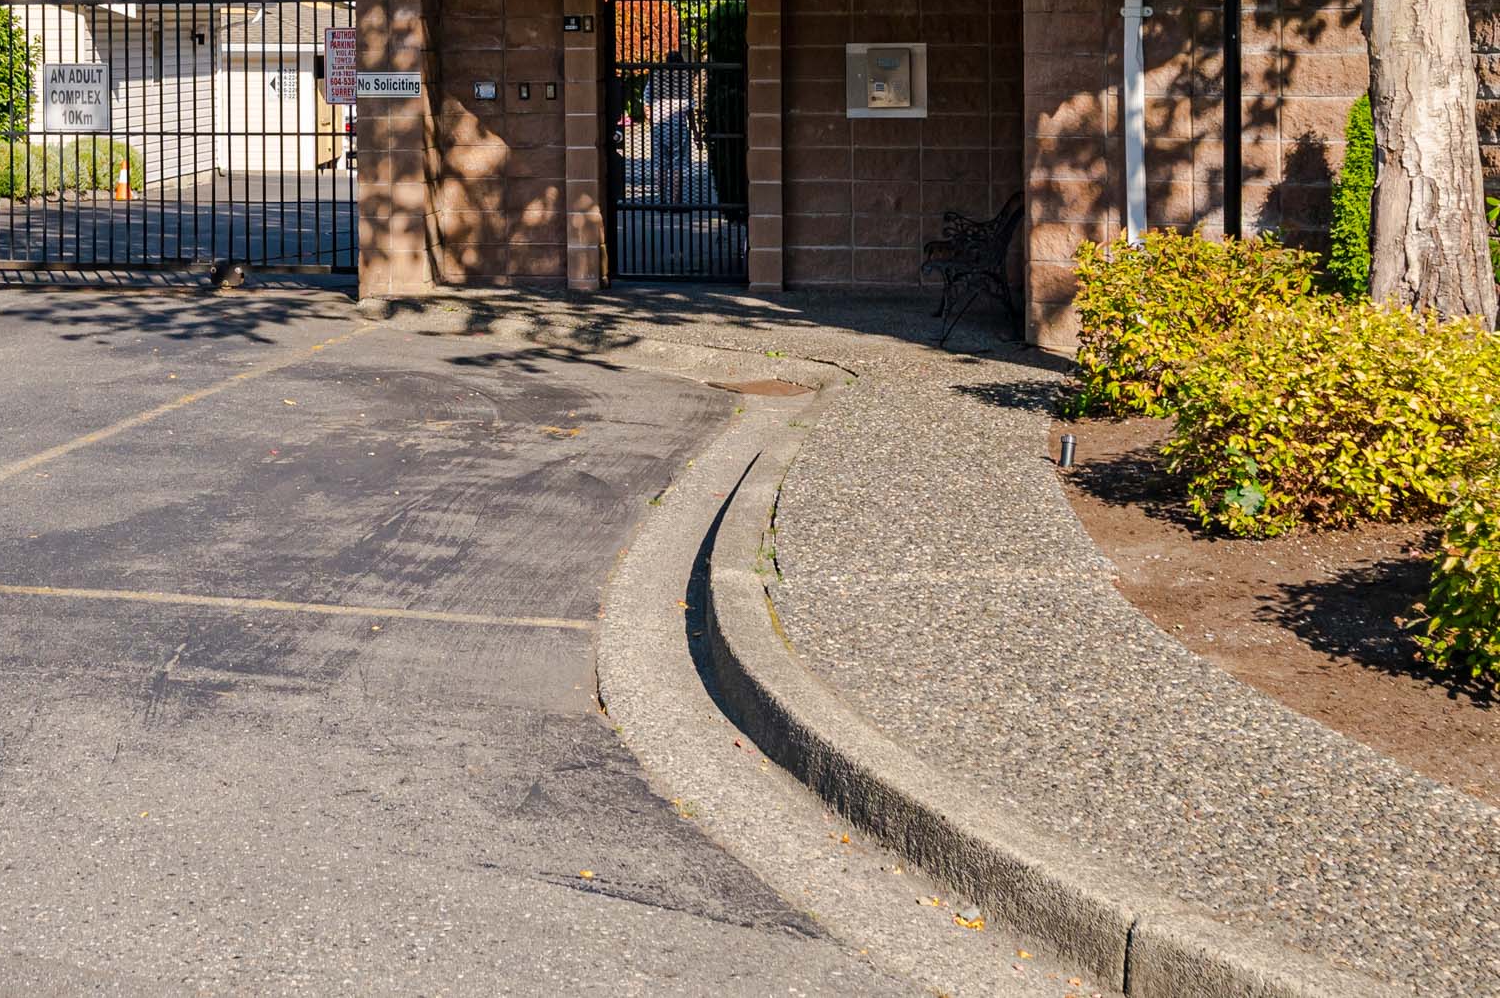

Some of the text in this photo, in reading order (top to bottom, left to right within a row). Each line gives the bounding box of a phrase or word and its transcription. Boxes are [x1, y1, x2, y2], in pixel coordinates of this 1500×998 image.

[50, 68, 103, 84] AN ADULT
[331, 87, 355, 97] SURREY
[357, 78, 420, 94] No Soliciting
[50, 90, 101, 105] COMPLEX
[62, 110, 93, 125] 10Km
